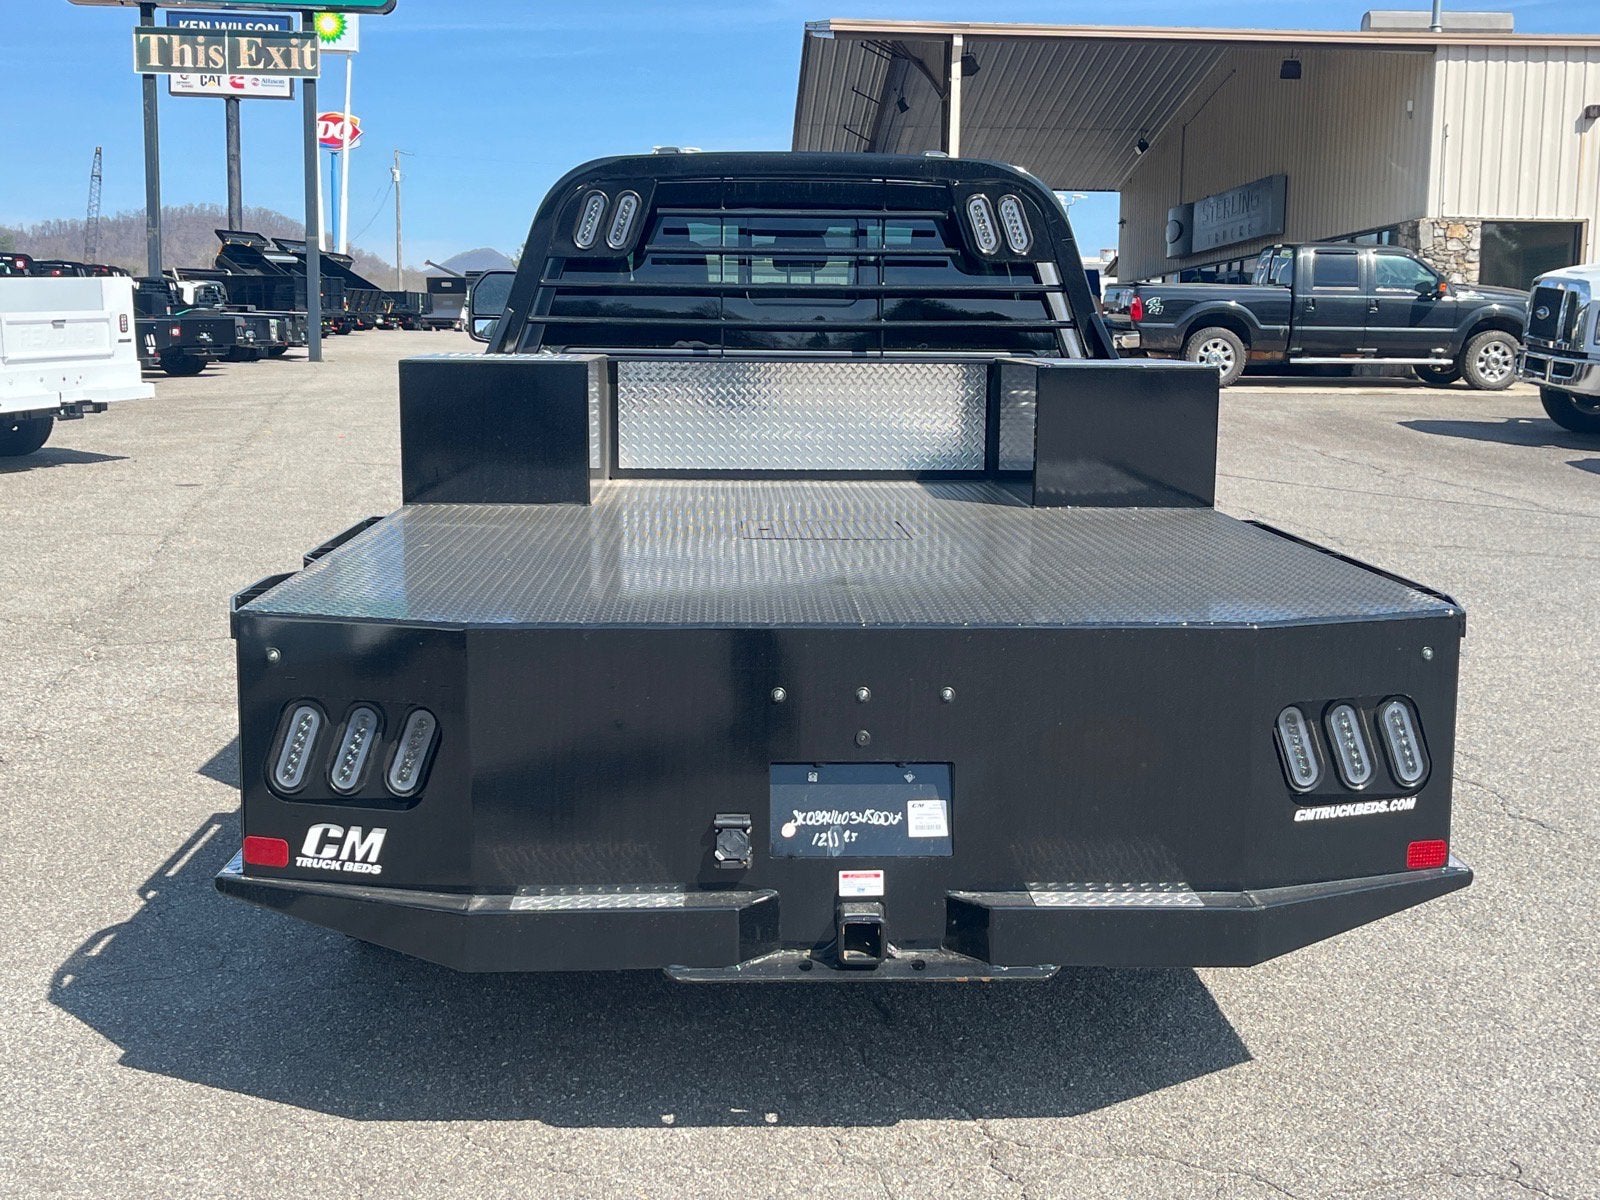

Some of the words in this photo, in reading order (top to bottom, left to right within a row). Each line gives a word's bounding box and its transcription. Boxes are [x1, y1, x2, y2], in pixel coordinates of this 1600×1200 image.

[179, 20, 210, 30] KEN
[215, 21, 279, 31] WILSON
[139, 33, 225, 69] This
[235, 36, 317, 71] Exit
[200, 75, 222, 87] CAT
[1202, 190, 1260, 224] STERLING
[1207, 222, 1256, 245] TRUCKS
[301, 823, 388, 863] CM
[295, 856, 342, 871] TRUCK
[342, 861, 383, 875] BEDS
